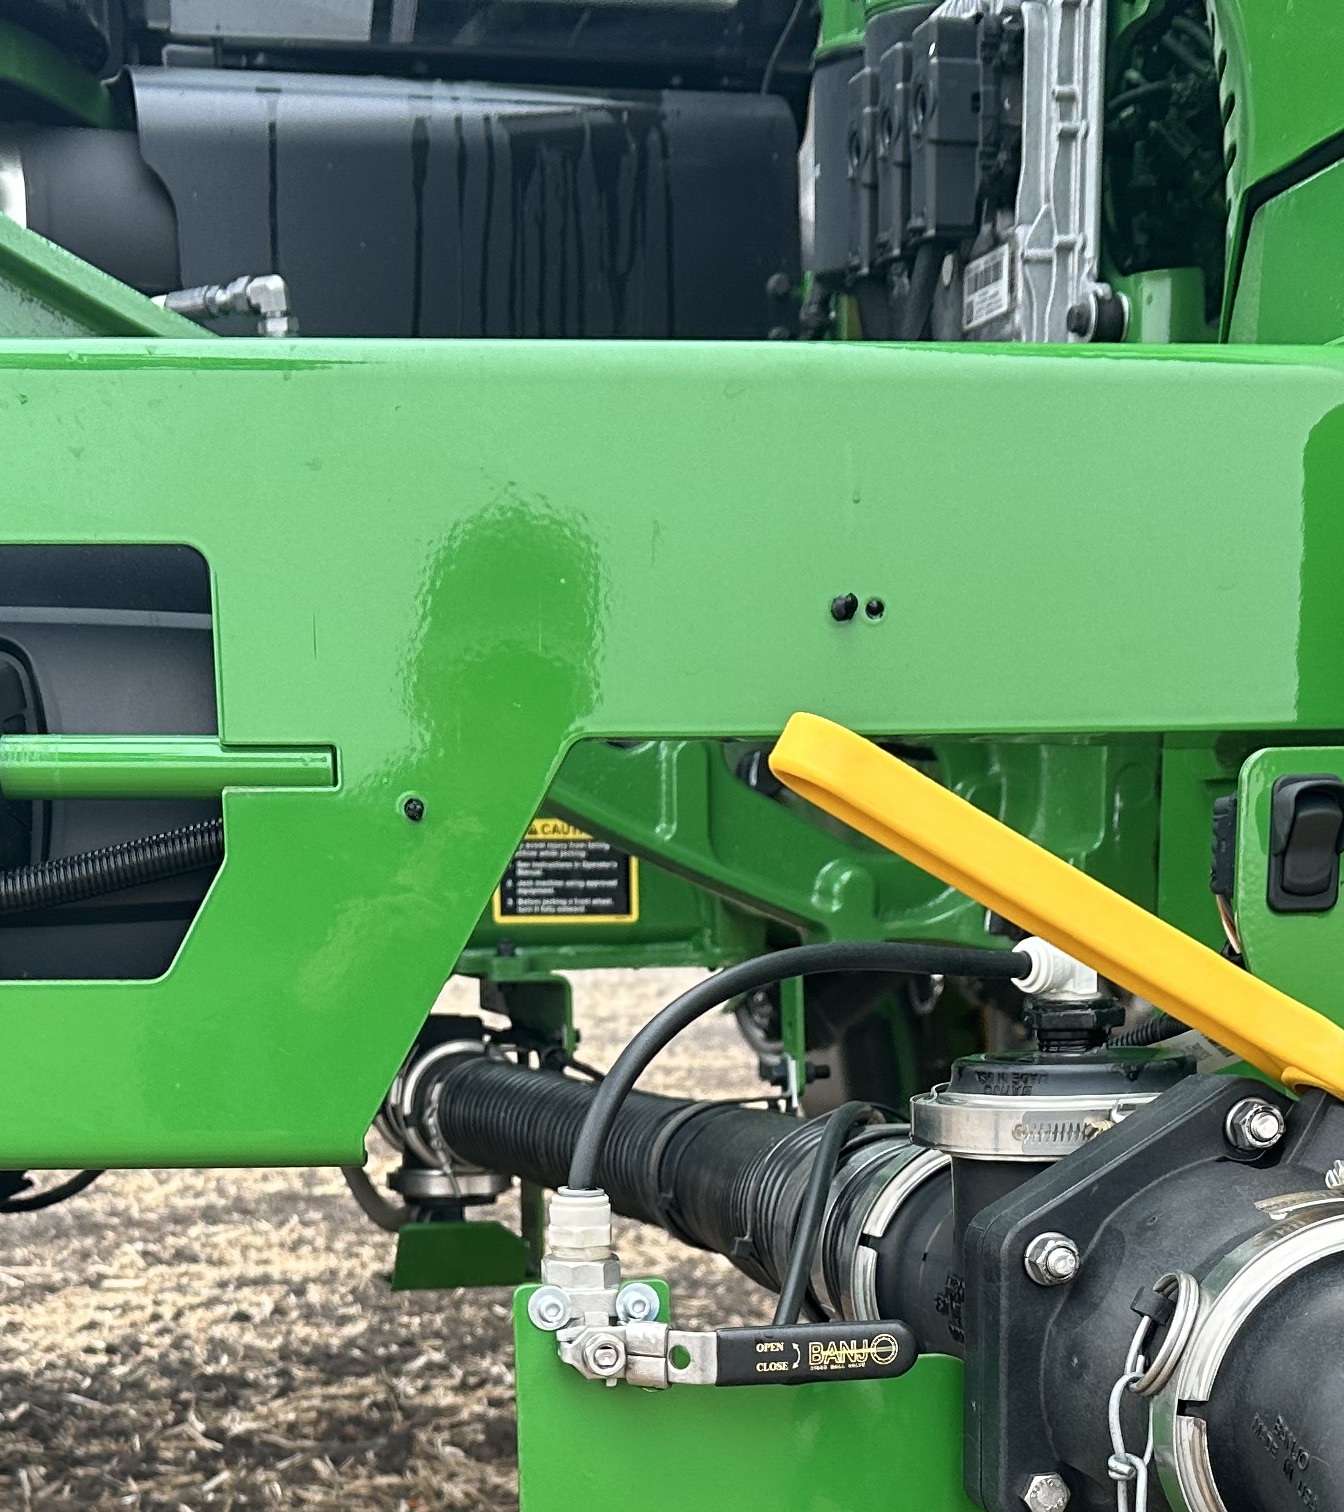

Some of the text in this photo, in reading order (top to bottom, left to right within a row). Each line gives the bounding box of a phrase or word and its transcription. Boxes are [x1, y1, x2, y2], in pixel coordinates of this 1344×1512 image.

[756, 1342, 785, 1353] OPEN
[808, 1333, 899, 1366] BANJO
[756, 1361, 789, 1372] CLOSE
